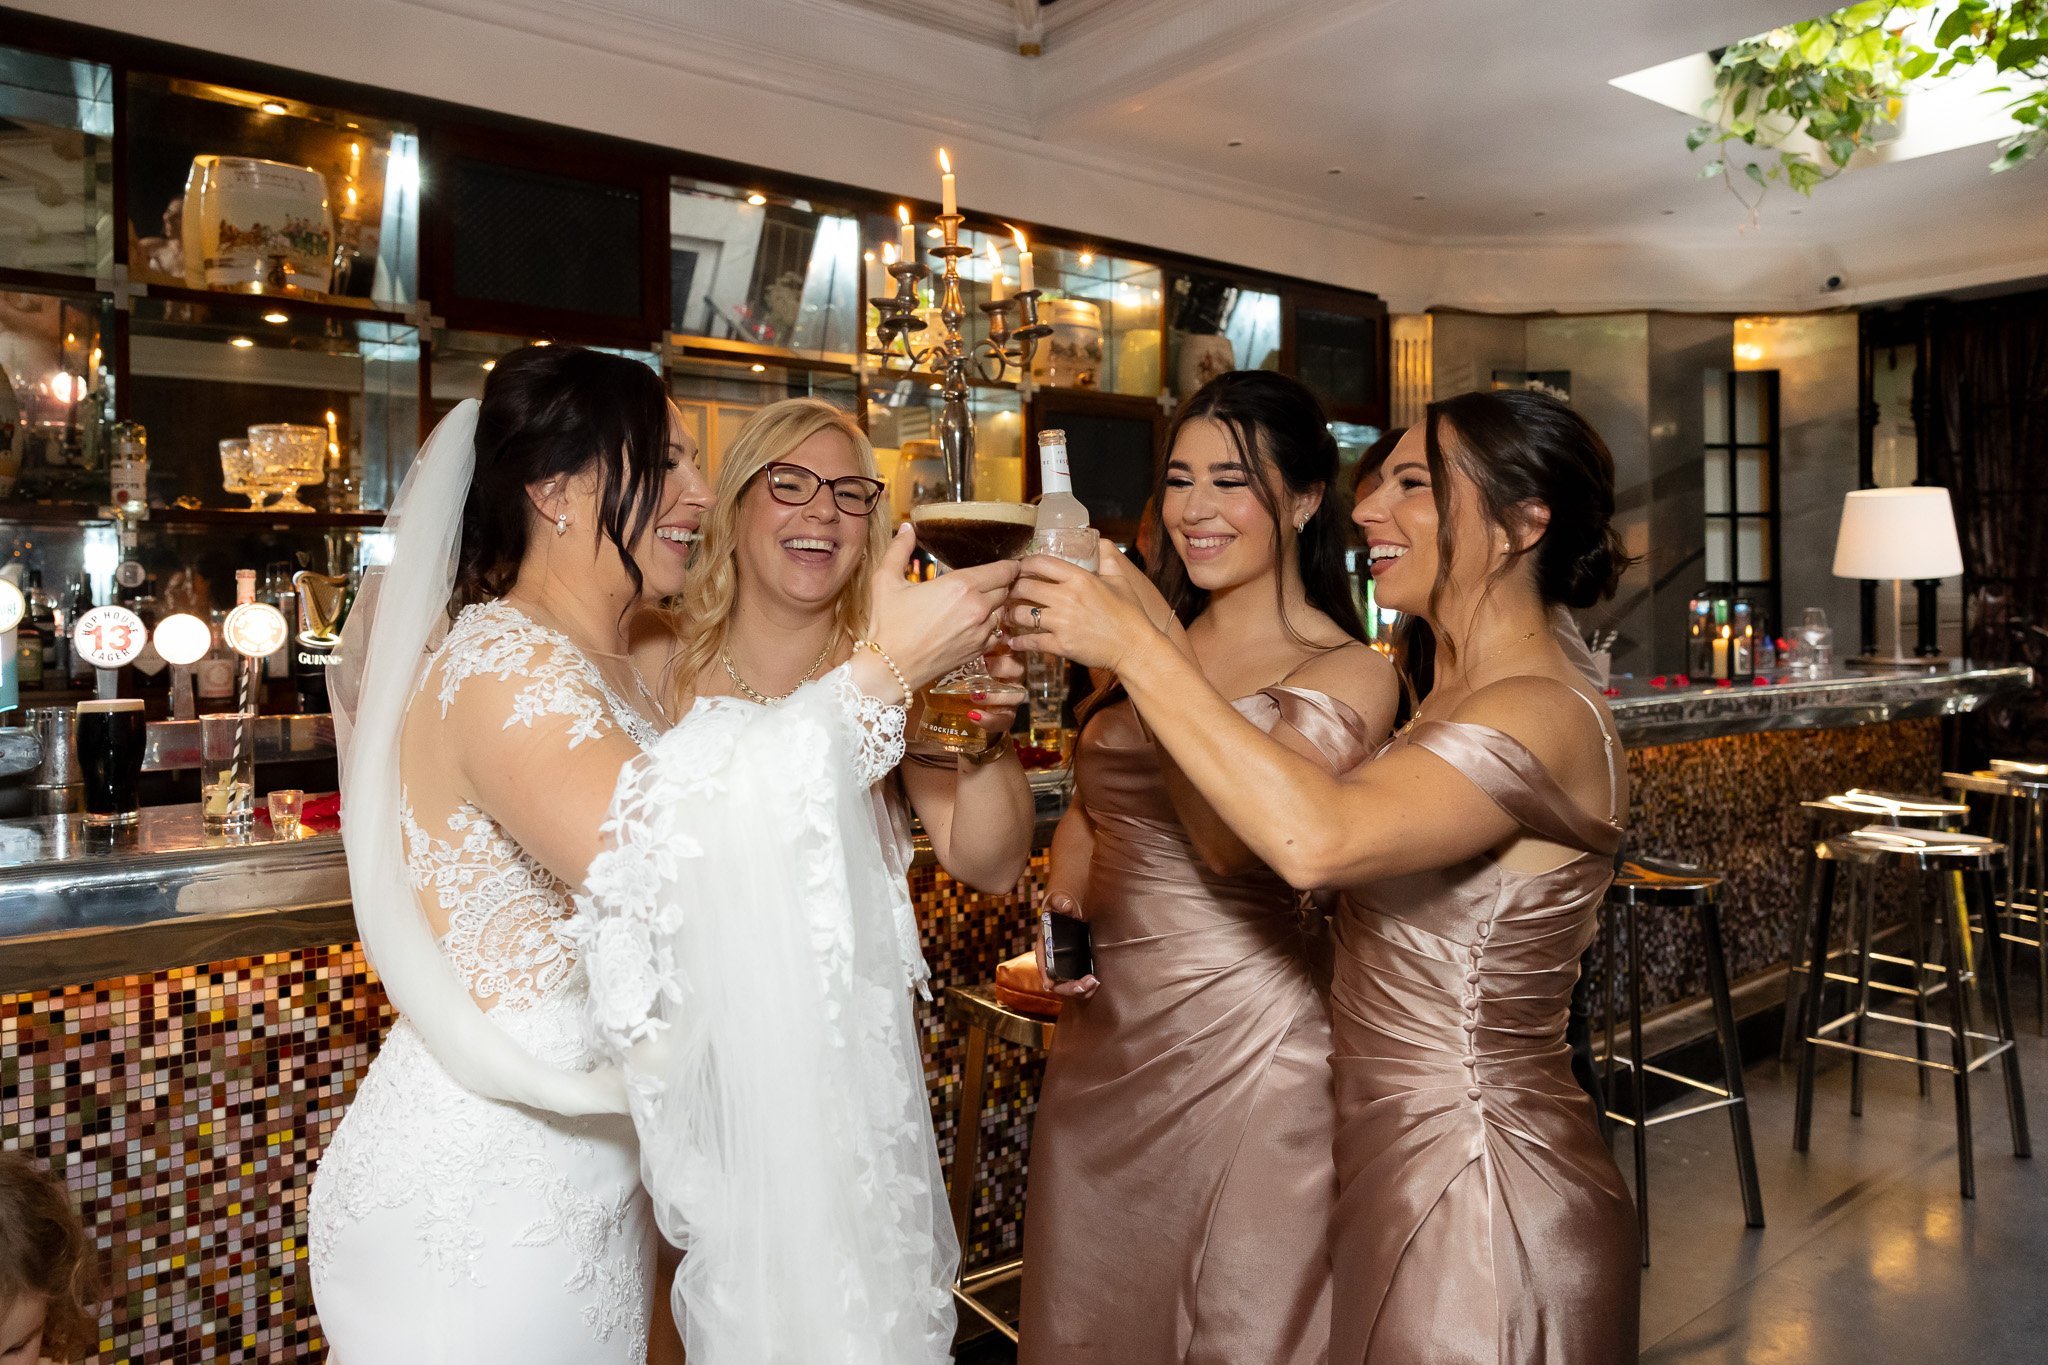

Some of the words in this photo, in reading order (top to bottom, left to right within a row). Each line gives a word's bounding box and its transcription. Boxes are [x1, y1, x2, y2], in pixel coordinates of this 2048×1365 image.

[82, 616, 97, 635] HOP
[104, 612, 138, 633] HOUSE
[86, 625, 131, 650] 13
[92, 649, 129, 660] LAGER
